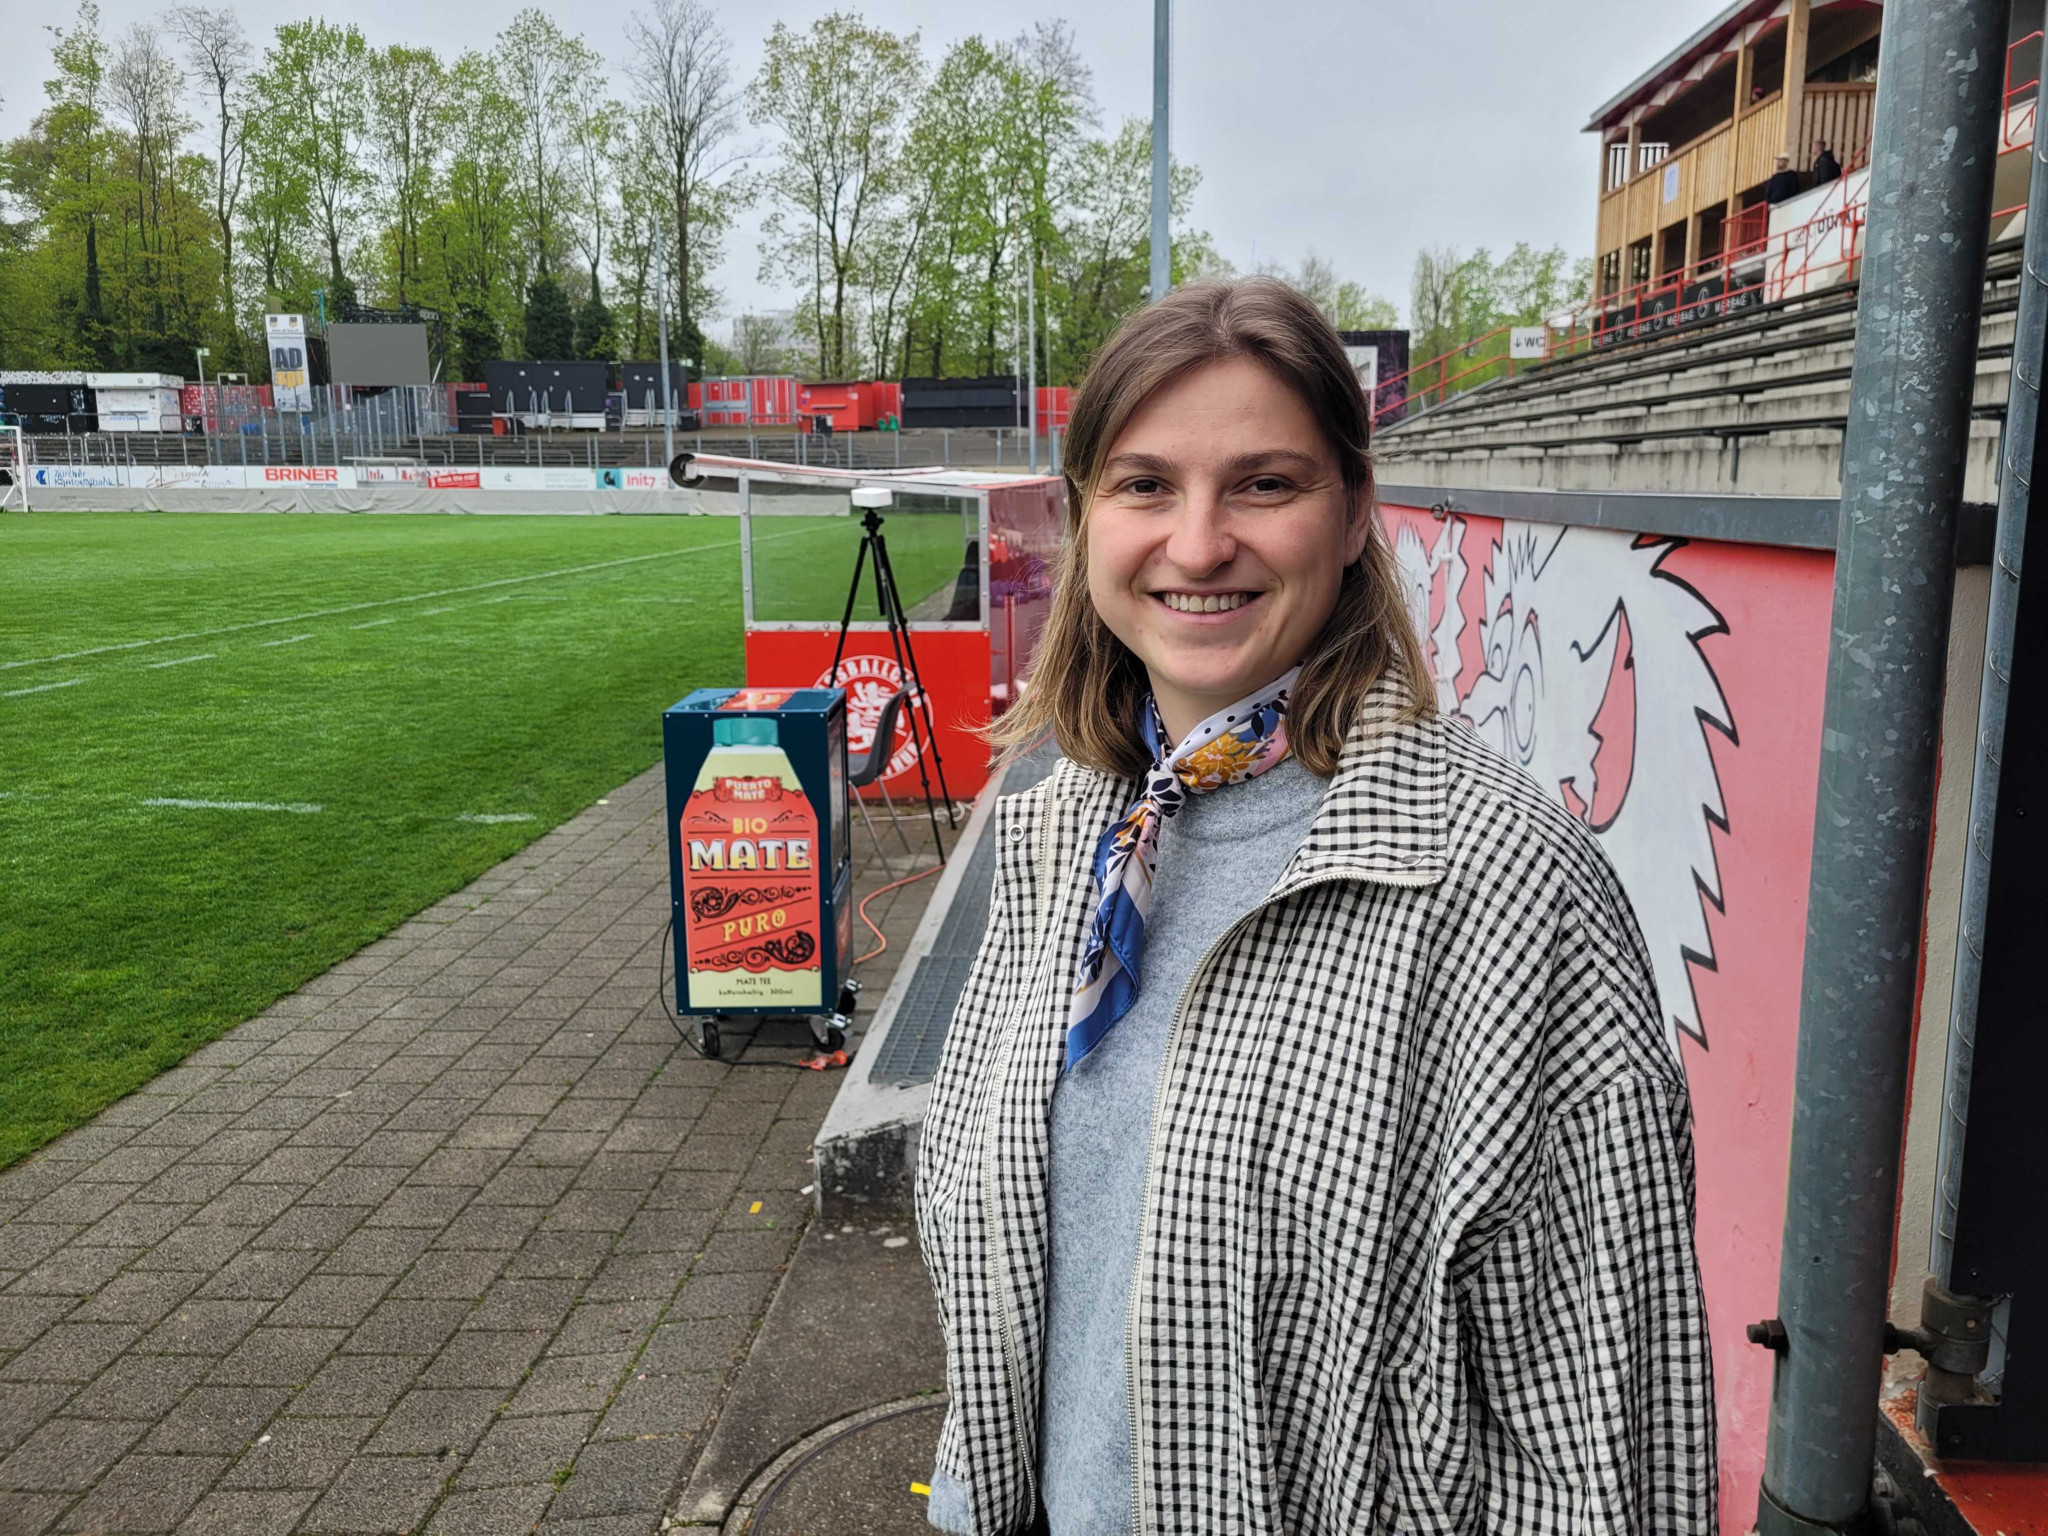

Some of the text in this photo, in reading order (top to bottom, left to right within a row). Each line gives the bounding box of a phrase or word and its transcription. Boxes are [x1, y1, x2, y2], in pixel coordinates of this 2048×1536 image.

[1524, 336, 1545, 348] WC
[275, 347, 303, 370] AD
[265, 468, 338, 481] BRINER
[626, 472, 656, 488] Init7
[725, 778, 771, 791] PUERTO
[733, 789, 765, 800] MATE
[732, 817, 768, 835] BIO
[688, 838, 812, 871] MATE
[722, 908, 787, 943] PURO
[736, 976, 771, 986] MATE TEE
